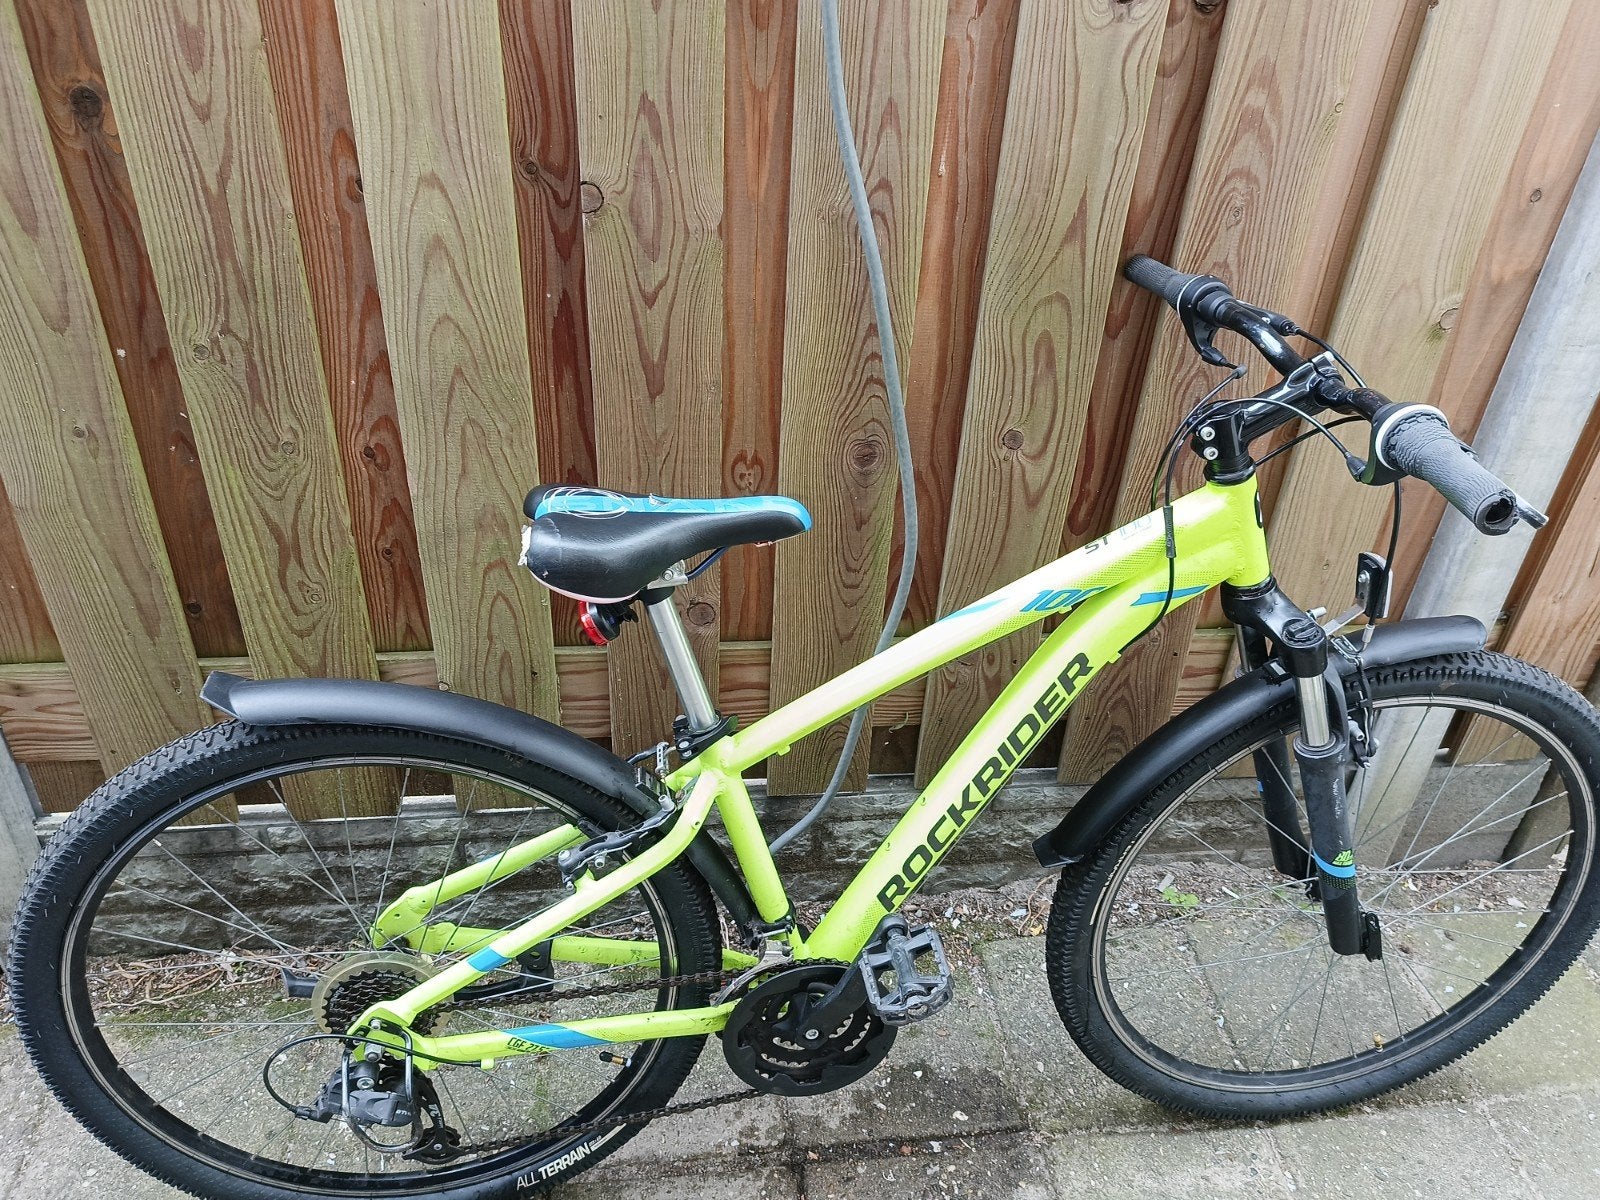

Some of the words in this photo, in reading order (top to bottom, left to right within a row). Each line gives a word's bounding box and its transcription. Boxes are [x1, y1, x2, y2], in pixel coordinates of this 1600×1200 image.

[877, 652, 1095, 912] ROCKRIDER
[516, 1171, 541, 1191] ALL
[538, 1142, 592, 1180] TERRAIN
